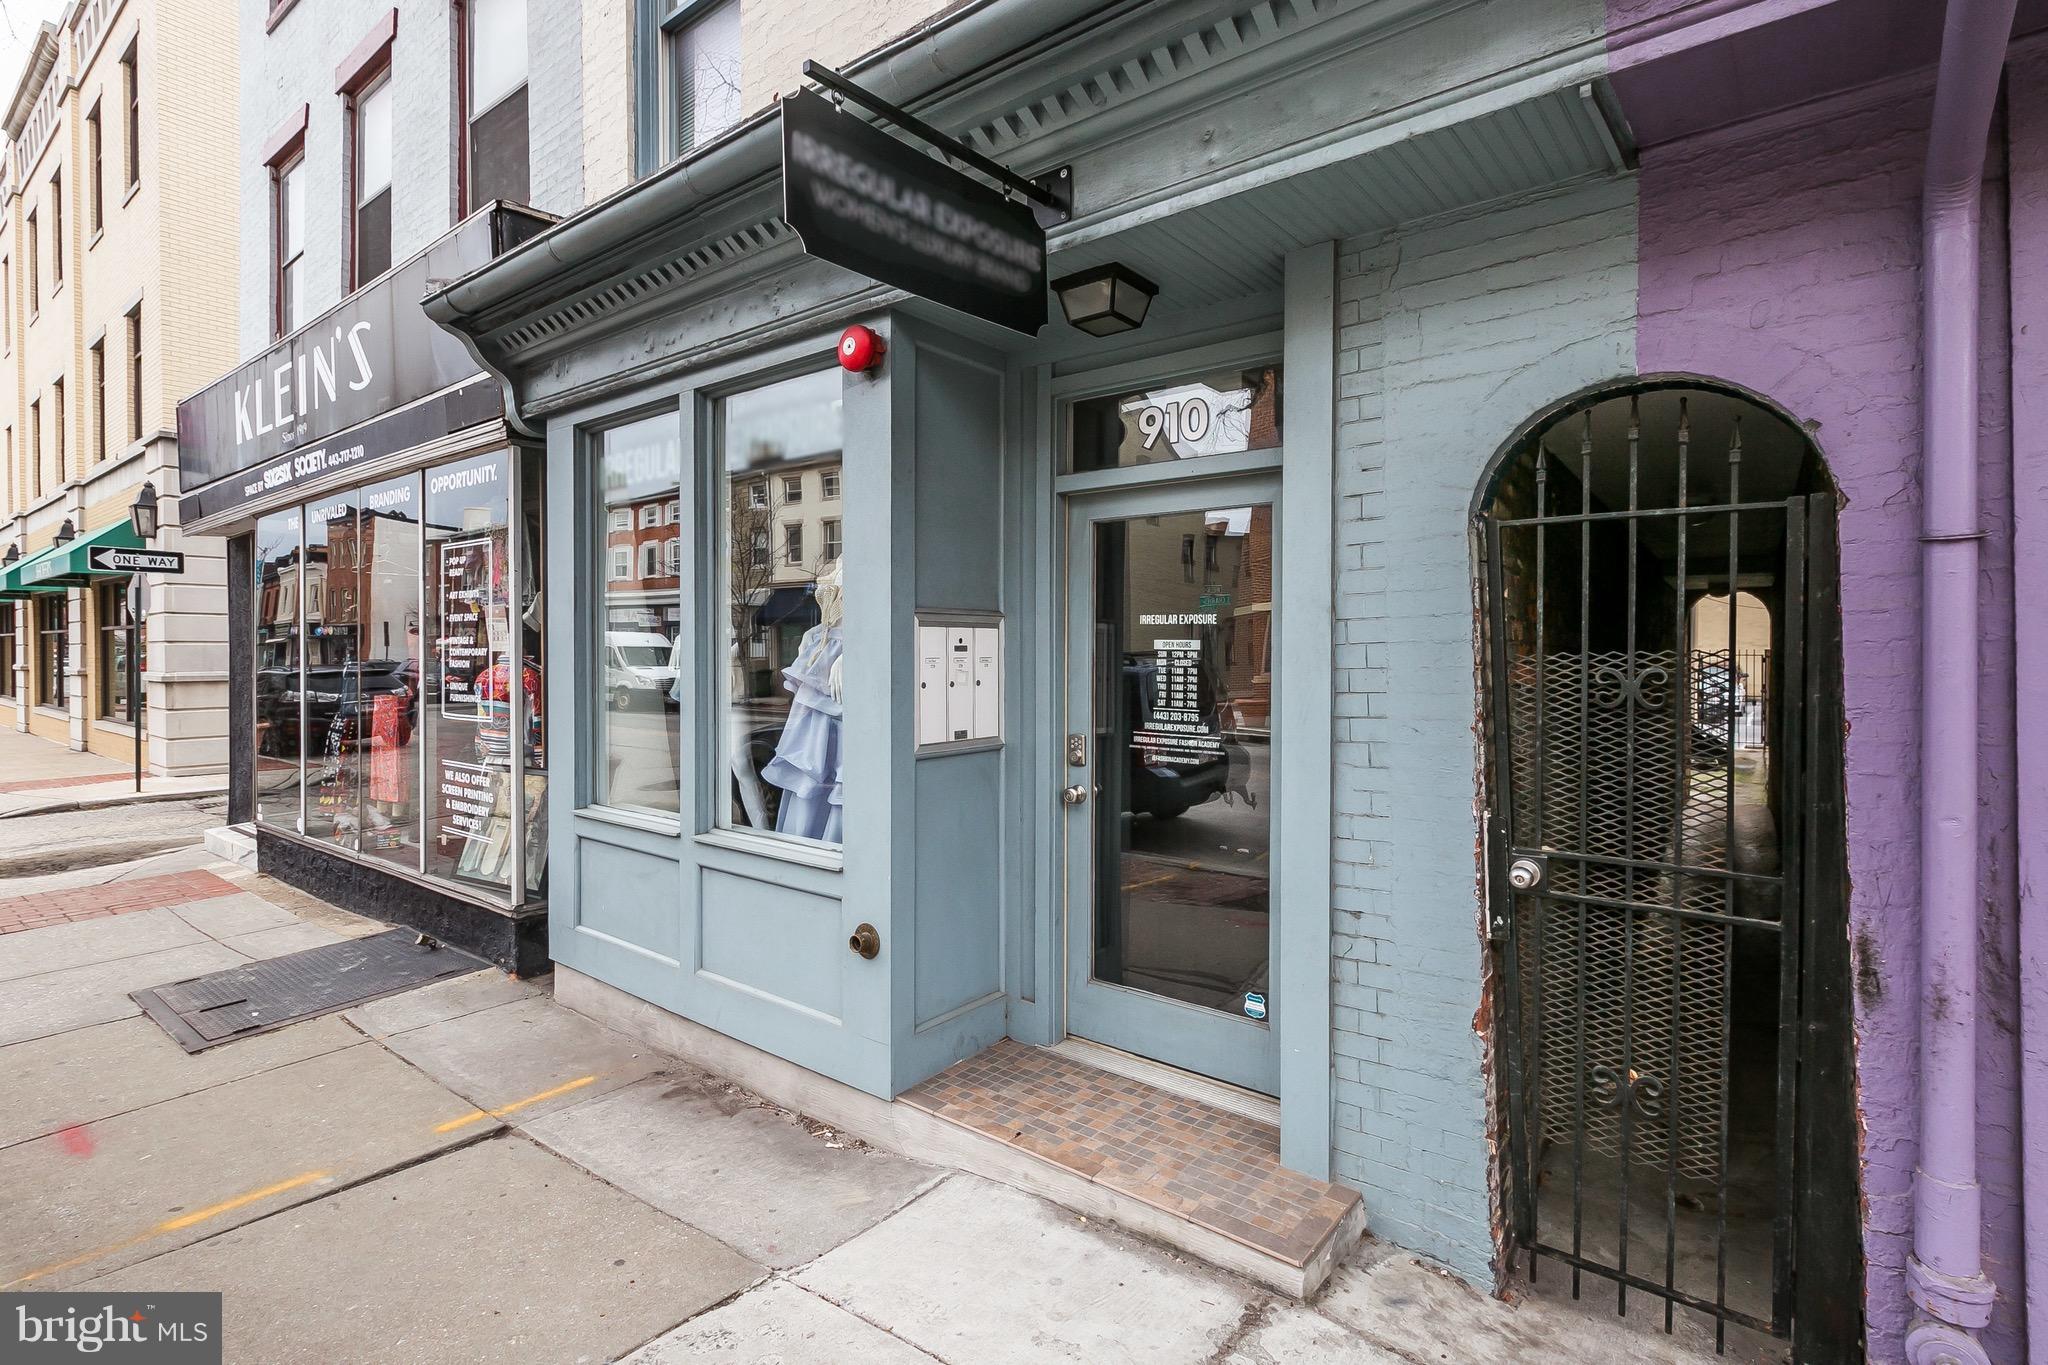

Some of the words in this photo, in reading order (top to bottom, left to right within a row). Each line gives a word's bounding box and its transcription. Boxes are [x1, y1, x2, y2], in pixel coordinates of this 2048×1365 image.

[235, 321, 373, 445] KLEIN'S
[1138, 397, 1209, 450] 910
[288, 516, 299, 531] THE
[311, 504, 347, 524] UNRIVALED
[369, 486, 411, 510] BRANDING
[431, 464, 498, 494] OPPORTUNITY.
[113, 555, 140, 565] ONE
[148, 557, 176, 567] WAY
[449, 557, 459, 566] POP
[460, 556, 467, 564] UP
[449, 613, 464, 622] EVENT
[464, 613, 479, 621] SPACE
[1139, 614, 1178, 625] IRREGULAR
[1179, 614, 1217, 625] EXPOSURE
[1175, 641, 1192, 649] HOURS
[449, 647, 488, 656] CONTEMPORARY
[1153, 711, 1169, 720] (443)
[1157, 737, 1179, 745] EXPOSURE
[1198, 741, 1221, 749] ACADEMY
[445, 769, 454, 781] WE
[455, 771, 470, 783] ALSO
[471, 775, 490, 787] OFFER
[442, 783, 463, 797] SCREEN
[463, 788, 494, 803] PRINTING
[446, 798, 451, 809] &
[451, 800, 490, 817] EMBROIDERY
[452, 814, 482, 831] SERVICES!
